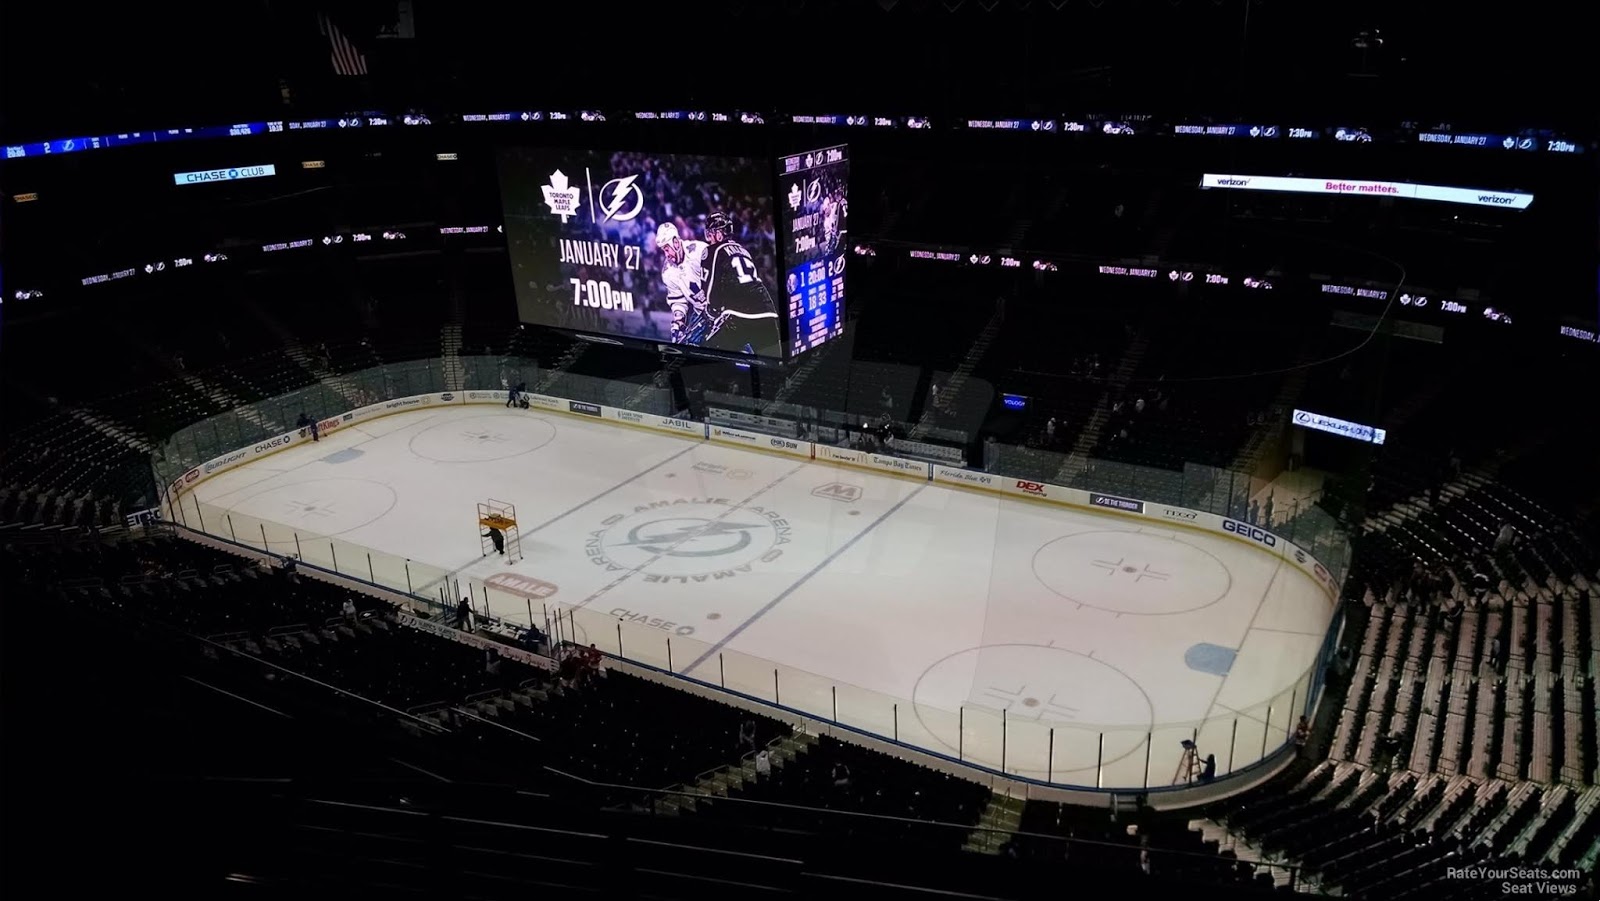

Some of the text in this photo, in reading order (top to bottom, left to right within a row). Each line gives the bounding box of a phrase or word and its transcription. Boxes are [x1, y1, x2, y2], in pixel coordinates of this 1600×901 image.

[994, 121, 1013, 130] JANUARY
[1014, 121, 1020, 129] 27
[1064, 122, 1084, 132] 7:30PM
[1206, 126, 1228, 135] JANUARY
[1228, 126, 1236, 135] 27
[1288, 128, 1312, 138] 7:30PM
[1419, 133, 1486, 146] WEDNESDAY, JANUARY 27
[44, 142, 51, 154] 2
[1548, 140, 1575, 152] 7:30PM
[186, 167, 265, 183] CHASE CLUB
[1217, 176, 1246, 186] verizon
[1325, 182, 1399, 194] Better matters.
[549, 192, 574, 200] TORONTO
[1478, 194, 1512, 206] verizon
[559, 239, 640, 271] JANUARY 27
[936, 252, 954, 261] JANUARY
[954, 254, 960, 262] 27
[828, 260, 834, 277] 2
[1001, 258, 1020, 268] 7:00PM
[808, 267, 826, 286] 20:00
[1099, 266, 1158, 278] WEDNESDAY, JANUARY 27
[800, 271, 806, 288] 1
[1206, 274, 1228, 284] 7:00PM
[570, 278, 634, 312] 7:00PM
[818, 290, 827, 306] 33
[1322, 284, 1387, 300] WEDNESDAY, JANUARY 27
[1441, 300, 1466, 314] 7:00PM
[1560, 325, 1596, 342] WEDNESDAY,
[662, 418, 692, 429] JABIL
[1312, 418, 1350, 432] LEXUS
[254, 438, 282, 453] CHASE
[223, 452, 247, 464] LIGHT
[893, 460, 904, 469] Bay
[940, 470, 978, 482] Florida Blue
[1016, 480, 1045, 492] DEX
[1165, 509, 1197, 520] TECO
[634, 497, 792, 545] AMALIE ARENA
[1222, 520, 1276, 548] GEICO
[585, 529, 752, 584] AMALIE ARENA
[490, 575, 552, 596] AMALIE
[608, 607, 676, 632] CHASE
